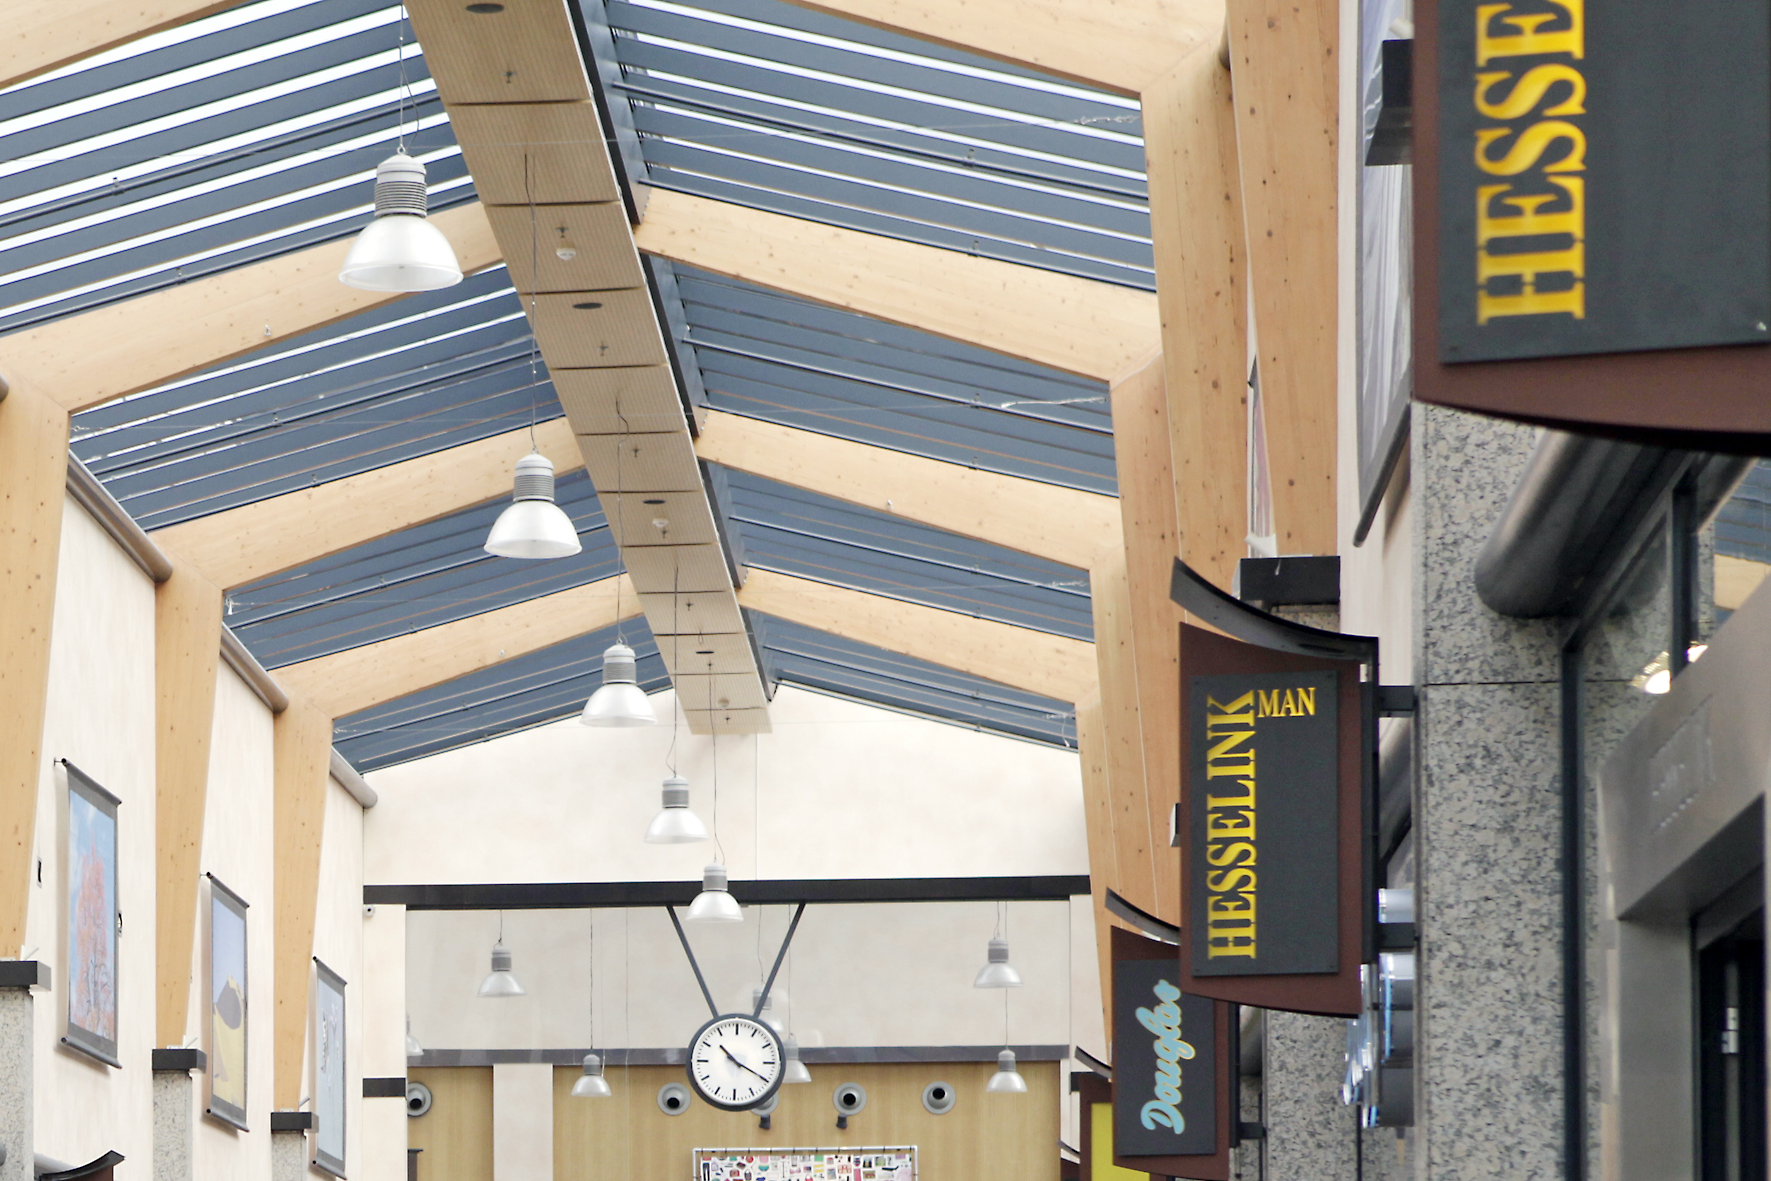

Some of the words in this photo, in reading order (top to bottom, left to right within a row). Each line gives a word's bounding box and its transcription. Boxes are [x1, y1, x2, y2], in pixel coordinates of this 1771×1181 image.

[1257, 687, 1316, 718] MAN
[1206, 689, 1257, 960] HESSELINK
[1135, 979, 1196, 1134] Douglas
